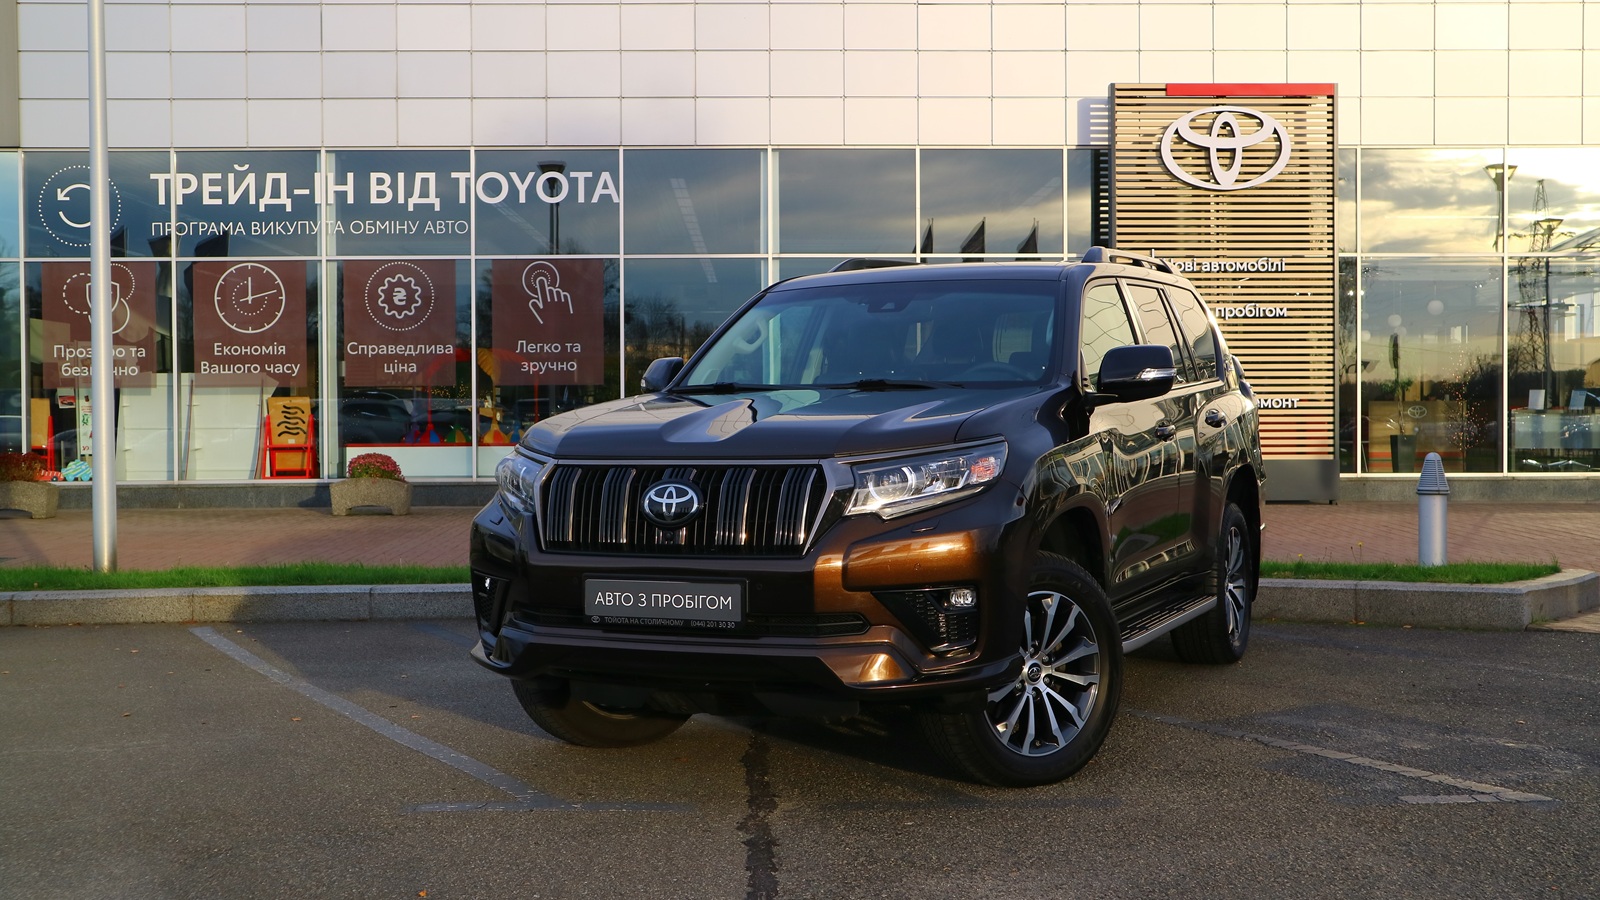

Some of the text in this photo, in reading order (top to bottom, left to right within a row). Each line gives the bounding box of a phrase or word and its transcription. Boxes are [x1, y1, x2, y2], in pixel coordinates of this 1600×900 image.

[150, 164, 620, 212] ТРЕЙД-ІН ВІД TOYOTA
[151, 220, 469, 236] ПРОГРАМА ВИКУПУ ТА ОБМІНУ АВТО
[1163, 257, 1286, 272] ові автомобілі
[1215, 303, 1288, 320] пробігом
[53, 344, 146, 361] Прозо та
[214, 342, 286, 356] Економія
[347, 341, 454, 356] Справедлива
[516, 340, 581, 353] Легко та
[61, 362, 139, 376] безчно
[201, 361, 300, 377] Вашого часу
[384, 360, 417, 374] ціна
[520, 360, 577, 374] зручно
[1258, 398, 1299, 409] монт
[595, 592, 732, 610] АВТО З ПРОБІГОМ
[604, 616, 629, 624] ТОЙОТА
[640, 618, 684, 626] СТОЛИЧНОМУ
[727, 621, 736, 629] 30
